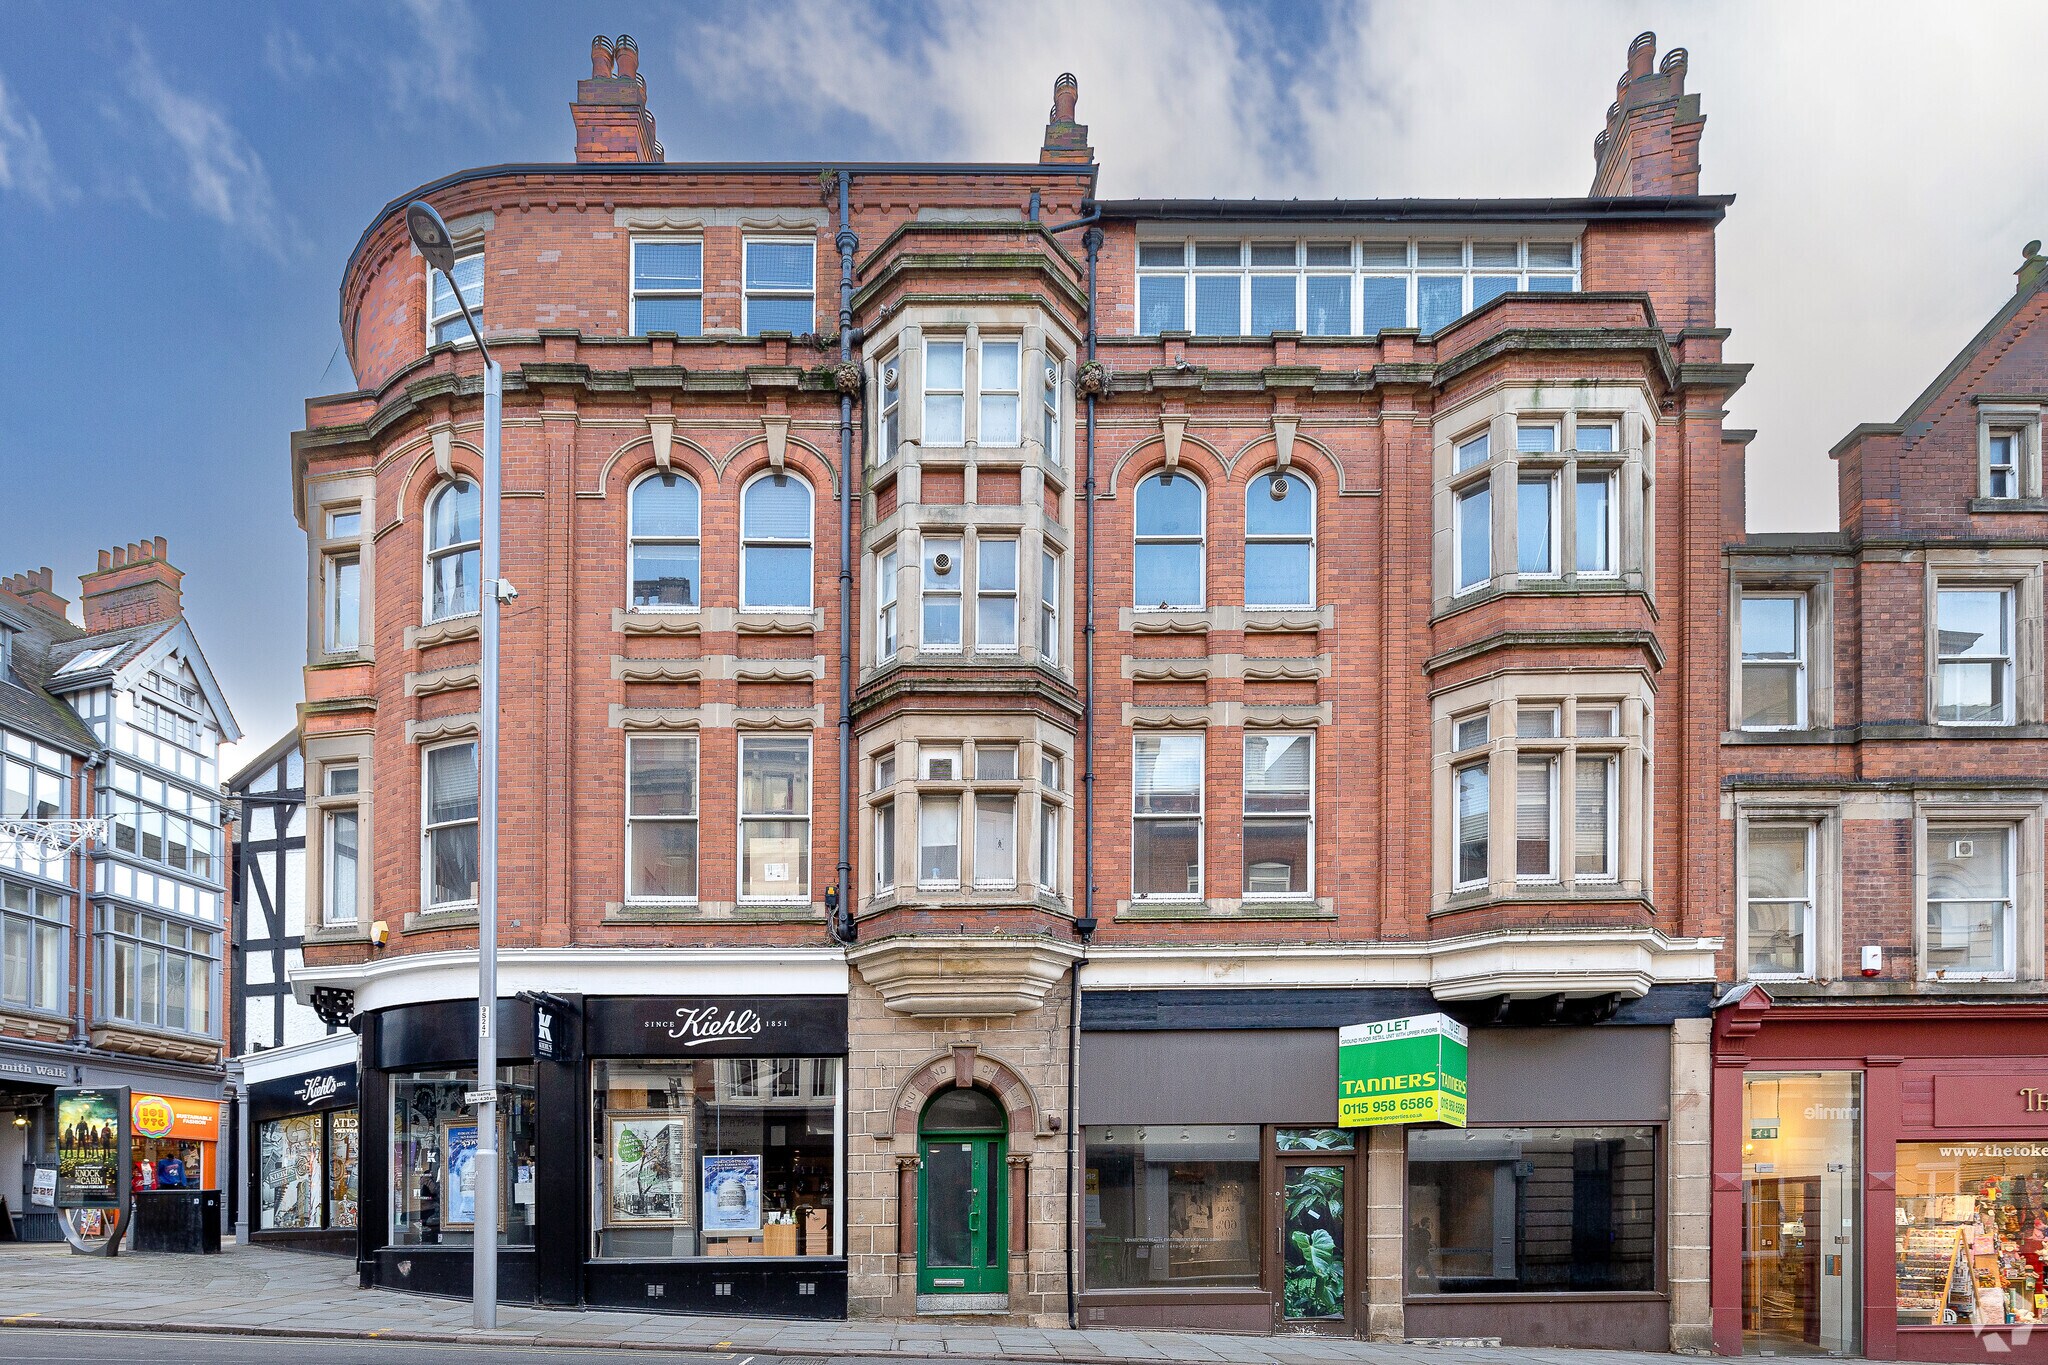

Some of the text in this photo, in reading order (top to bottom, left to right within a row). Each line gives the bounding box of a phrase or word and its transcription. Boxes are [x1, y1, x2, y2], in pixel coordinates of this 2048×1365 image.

[668, 1006, 761, 1038] Kiehl's
[1367, 1019, 1410, 1035] TO LET
[1341, 1037, 1357, 1045] GROUND
[35, 1066, 67, 1078] Walk
[302, 1076, 337, 1100] Kiehl's
[1343, 1096, 1434, 1115] 0115 958 6586
[142, 1107, 164, 1118] 101
[176, 1113, 213, 1121] SUSTAINABLE
[1352, 1112, 1423, 1123] www.tanners-properties.co.uk
[142, 1117, 166, 1127] VTG
[1939, 1144, 2048, 1157] www.thetoke
[74, 1169, 100, 1177] KNOCK
[80, 1177, 103, 1185] CABIN
